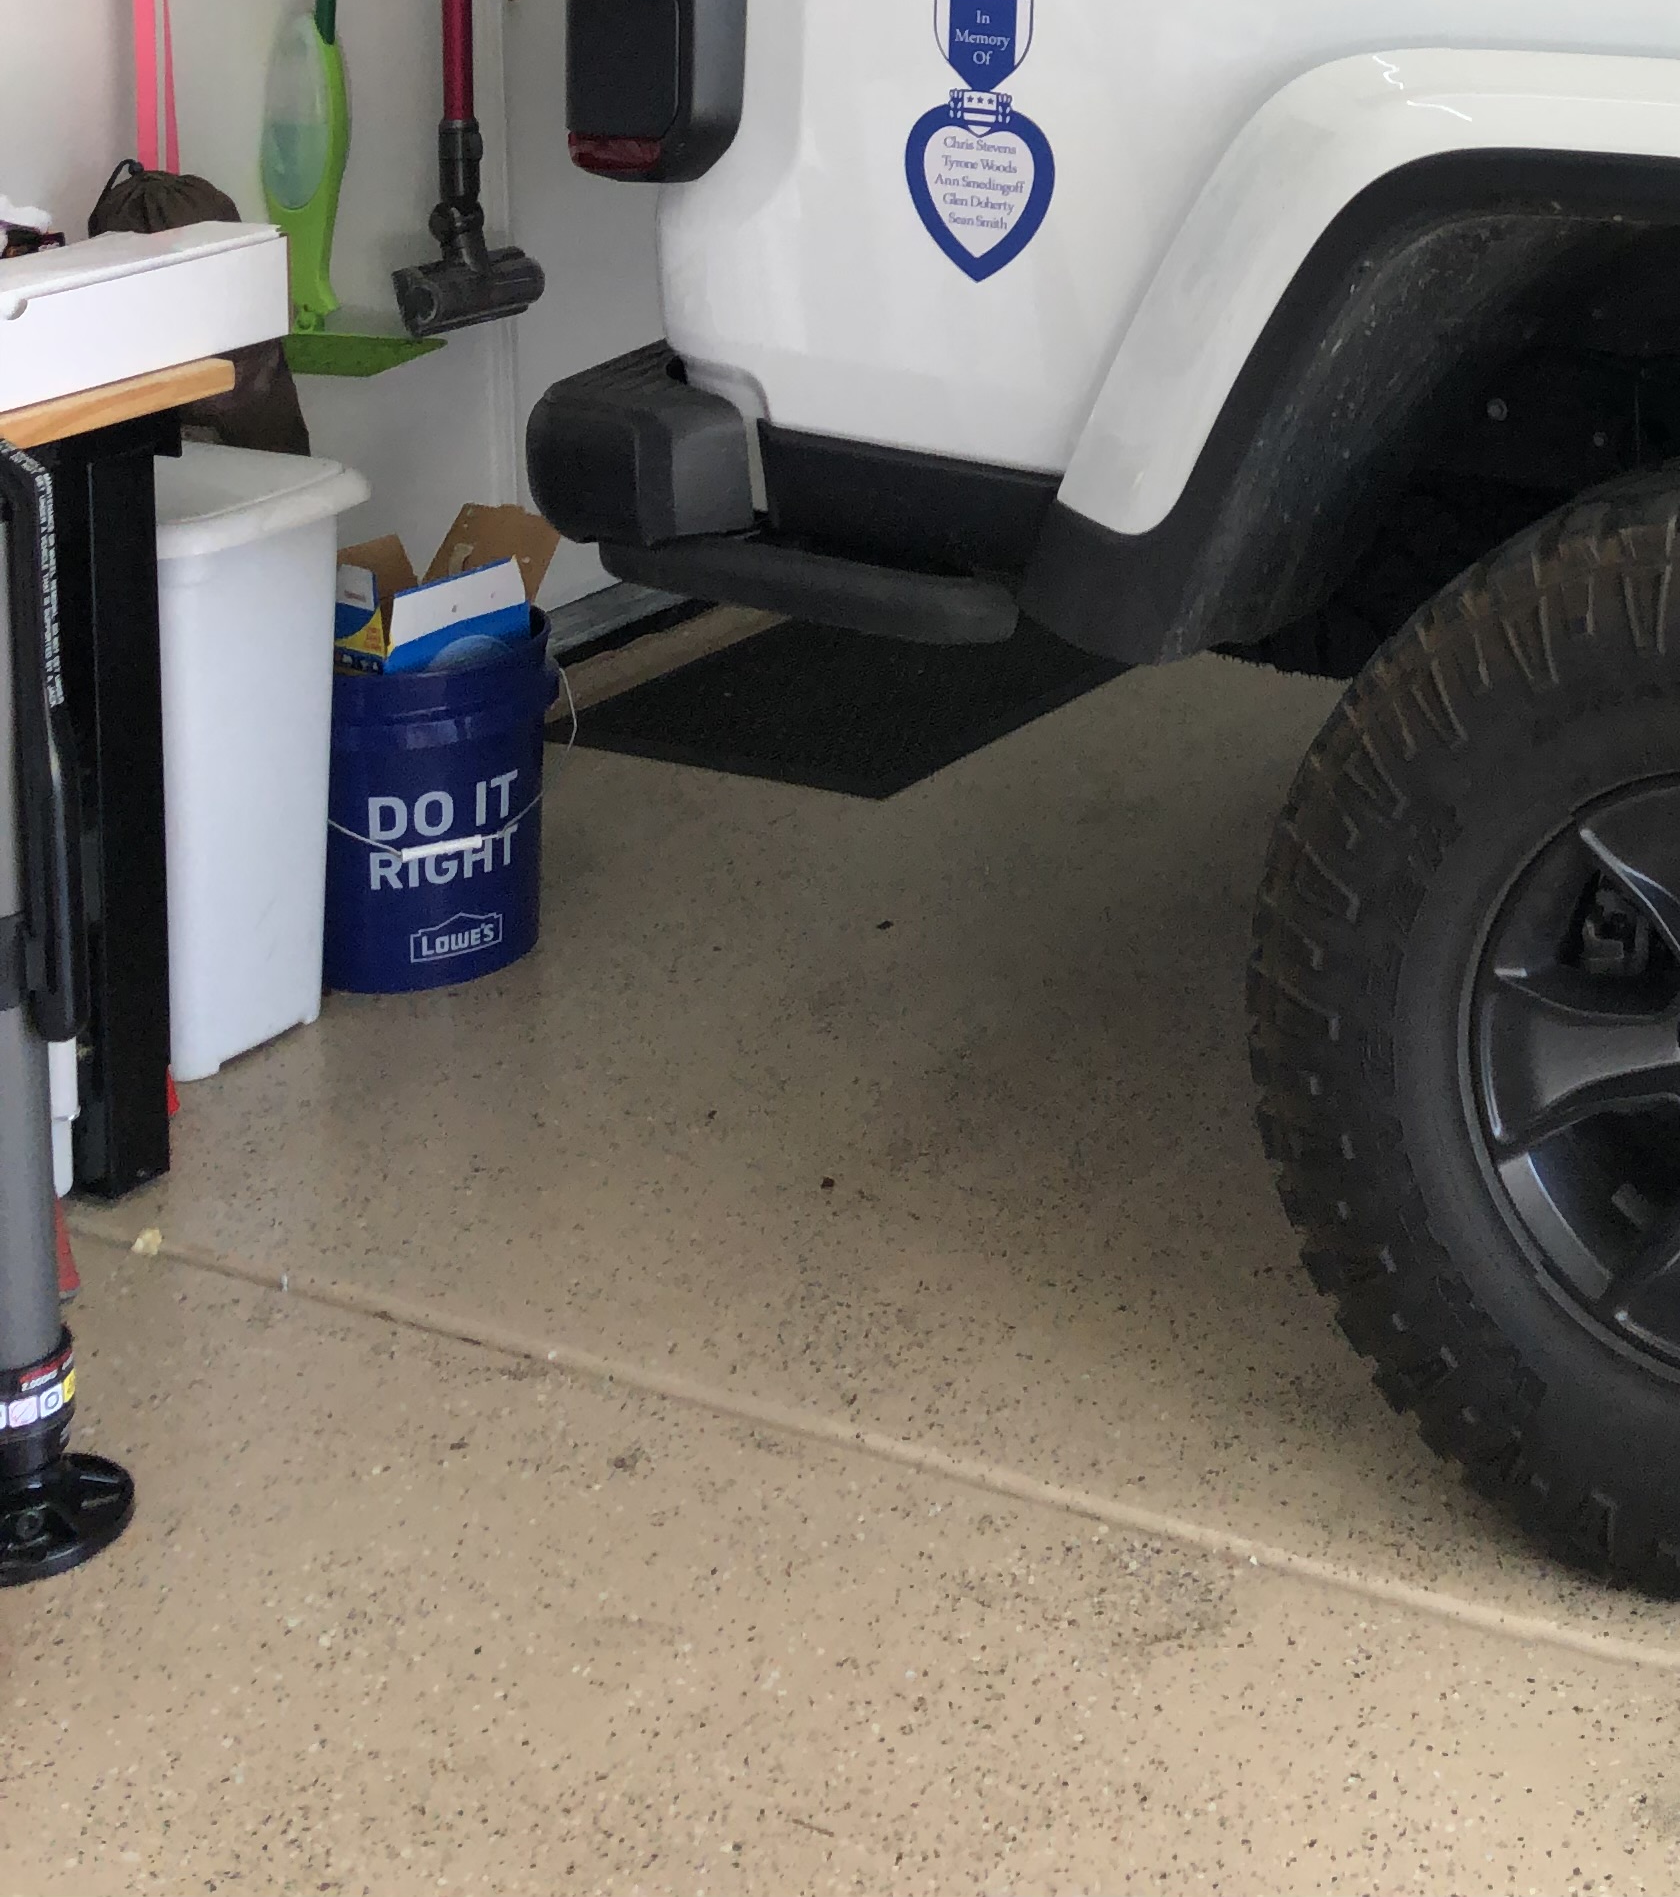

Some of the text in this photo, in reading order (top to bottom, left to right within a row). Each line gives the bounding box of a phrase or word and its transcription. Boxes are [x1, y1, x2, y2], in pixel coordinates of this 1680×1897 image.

[976, 10, 991, 24] In
[954, 28, 1011, 51] Memory
[972, 50, 993, 65] Of
[943, 136, 1017, 154] Chris Stevens
[941, 154, 1018, 173] Tyrone Woods
[934, 173, 960, 186] Ann
[942, 192, 1015, 215] Glen Doherty
[948, 211, 1008, 230] Sean Smith
[367, 768, 519, 841] DO IT
[368, 823, 519, 891] RIGHT
[420, 922, 495, 957] LOWE'S
